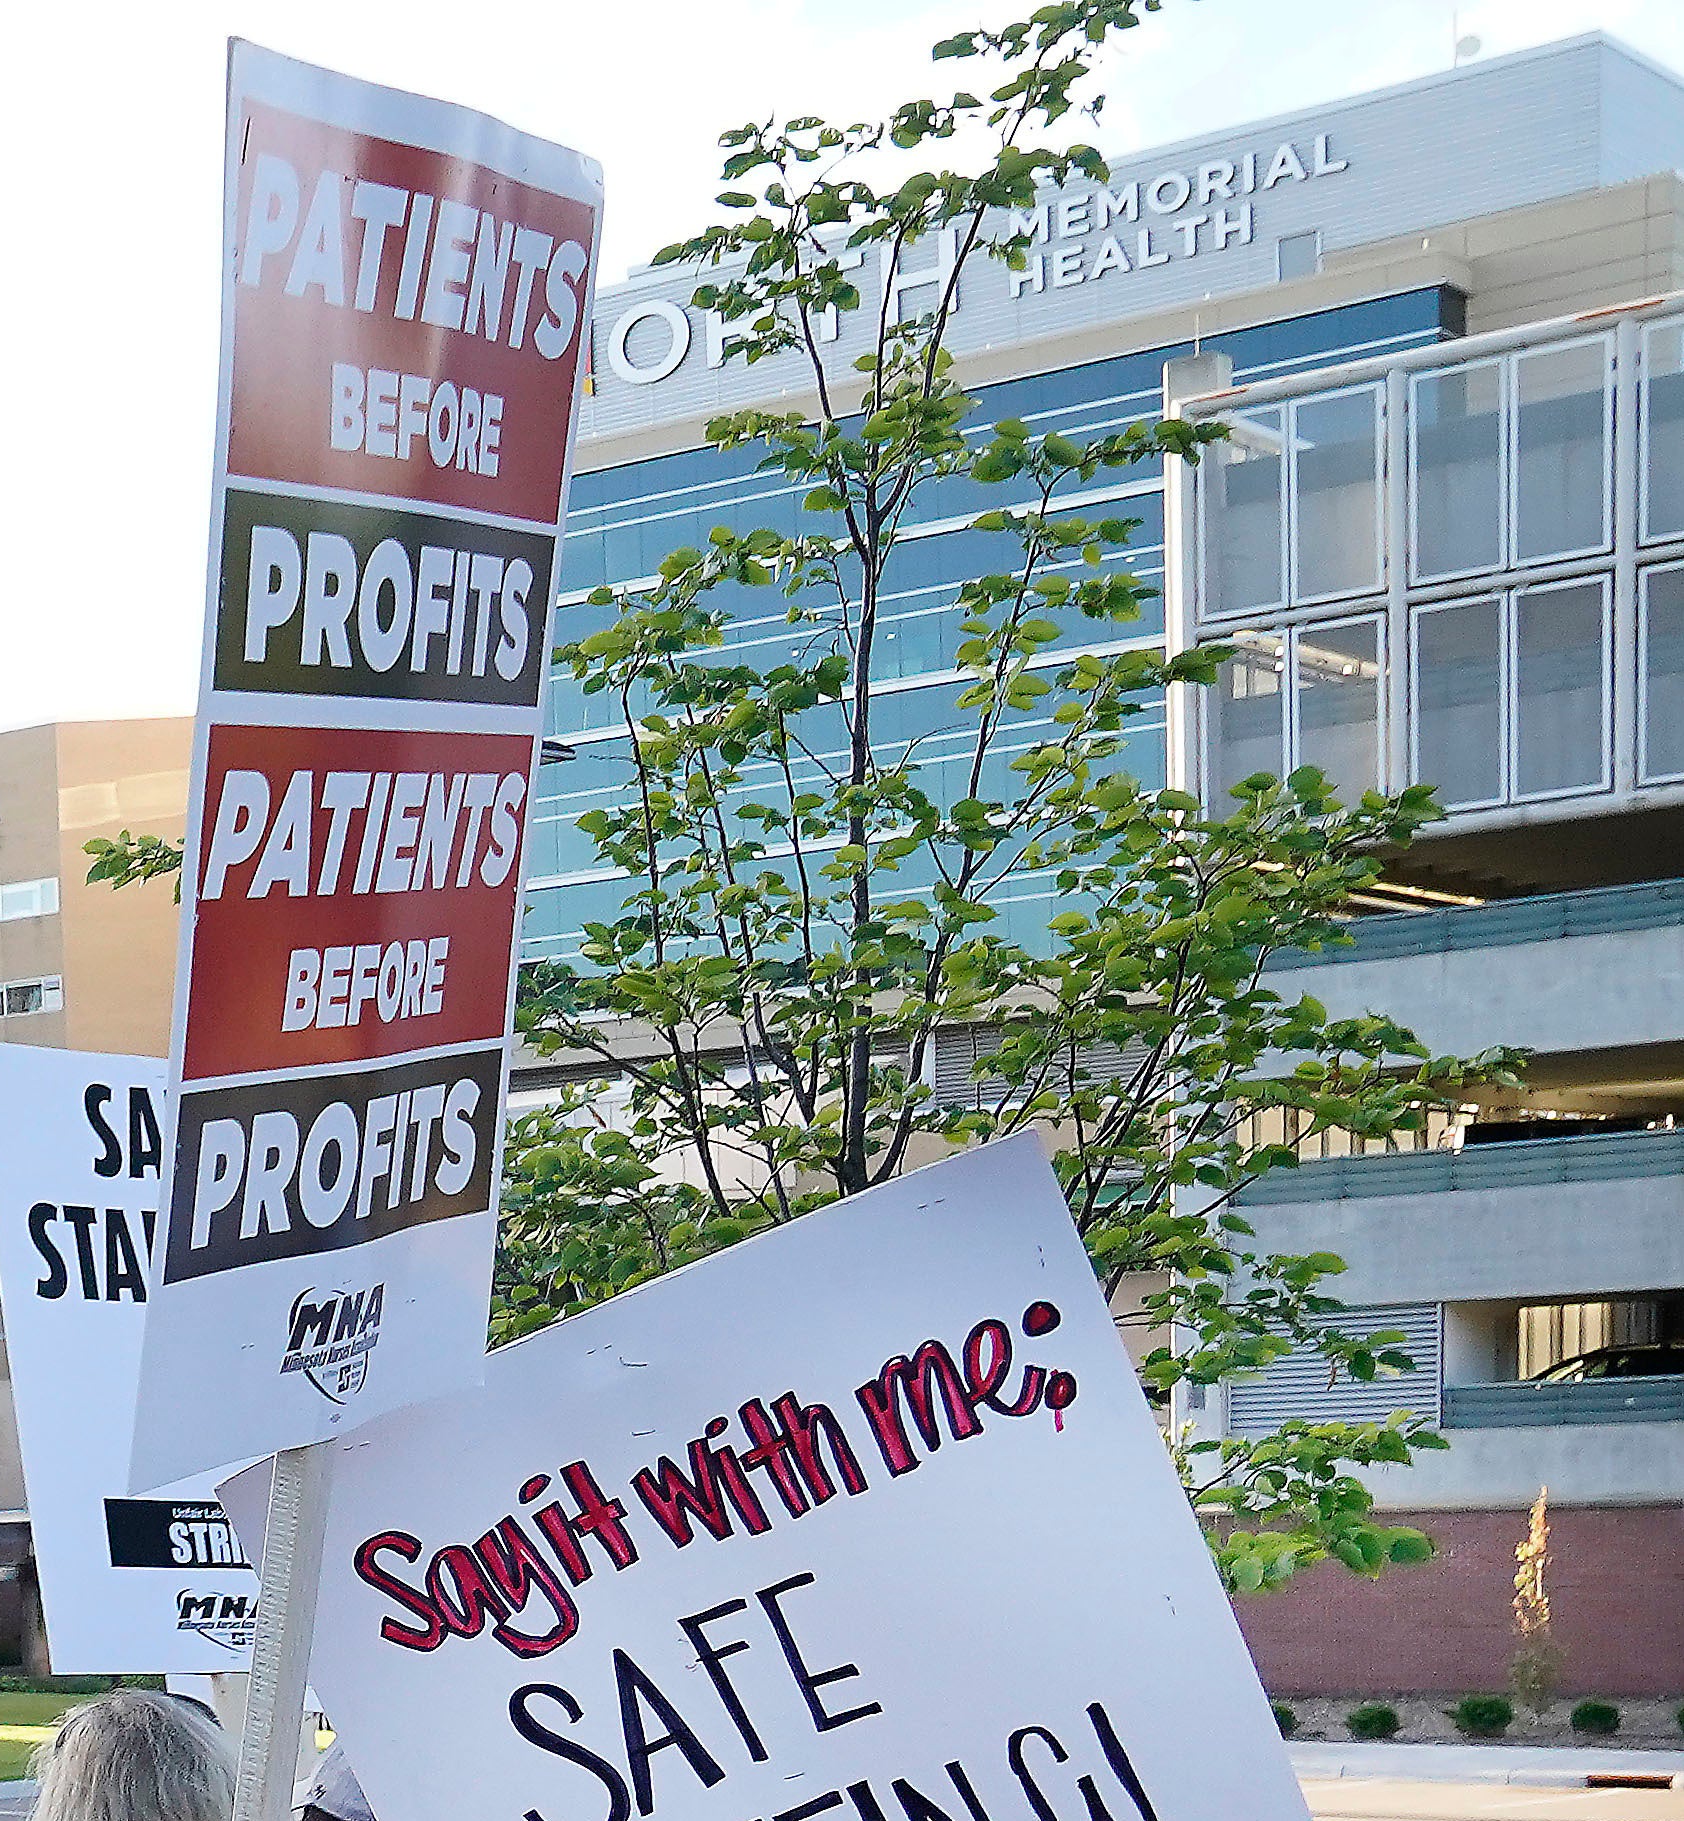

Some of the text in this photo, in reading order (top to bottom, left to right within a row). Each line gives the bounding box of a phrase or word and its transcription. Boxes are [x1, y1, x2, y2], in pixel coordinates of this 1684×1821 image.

[1009, 134, 1348, 246] MEMORIAL
[238, 151, 587, 362] PATIENTS
[1009, 203, 1255, 299] HEALTH
[330, 363, 504, 479] BEFORE
[243, 524, 534, 684] PROFITS
[201, 768, 527, 900] PATIENTS
[280, 936, 449, 1034] BEFORE
[84, 1083, 168, 1180] SA
[189, 1078, 483, 1252] PROFITS
[287, 1282, 384, 1352] MNA
[168, 1521, 251, 1565] STRI
[353, 1513, 580, 1659] Say
[519, 1459, 640, 1584] it
[631, 1390, 869, 1551] with
